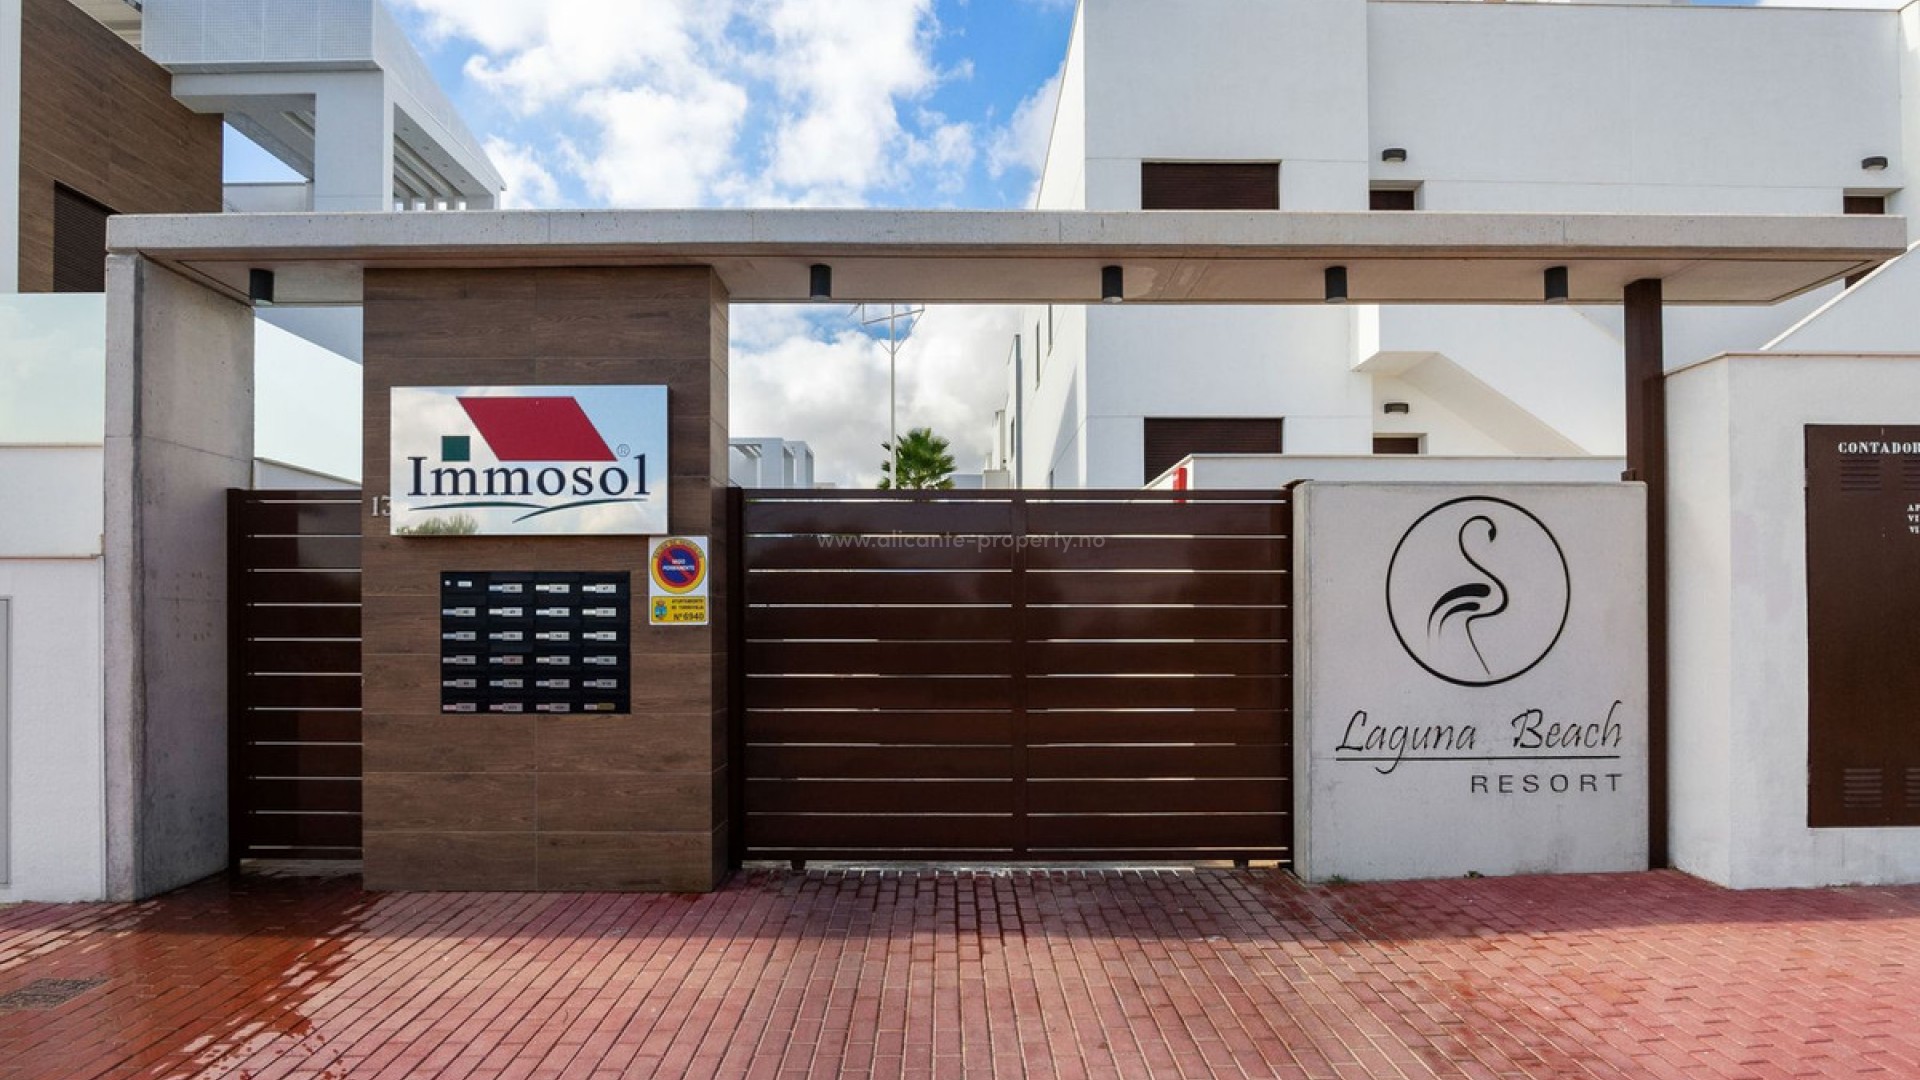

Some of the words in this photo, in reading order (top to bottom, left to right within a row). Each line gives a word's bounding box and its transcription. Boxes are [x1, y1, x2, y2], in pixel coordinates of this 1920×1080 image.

[408, 453, 650, 496] Immosol
[1336, 709, 1476, 774] Laguna
[1511, 699, 1622, 750] Beach
[1471, 773, 1623, 794] RESORT
